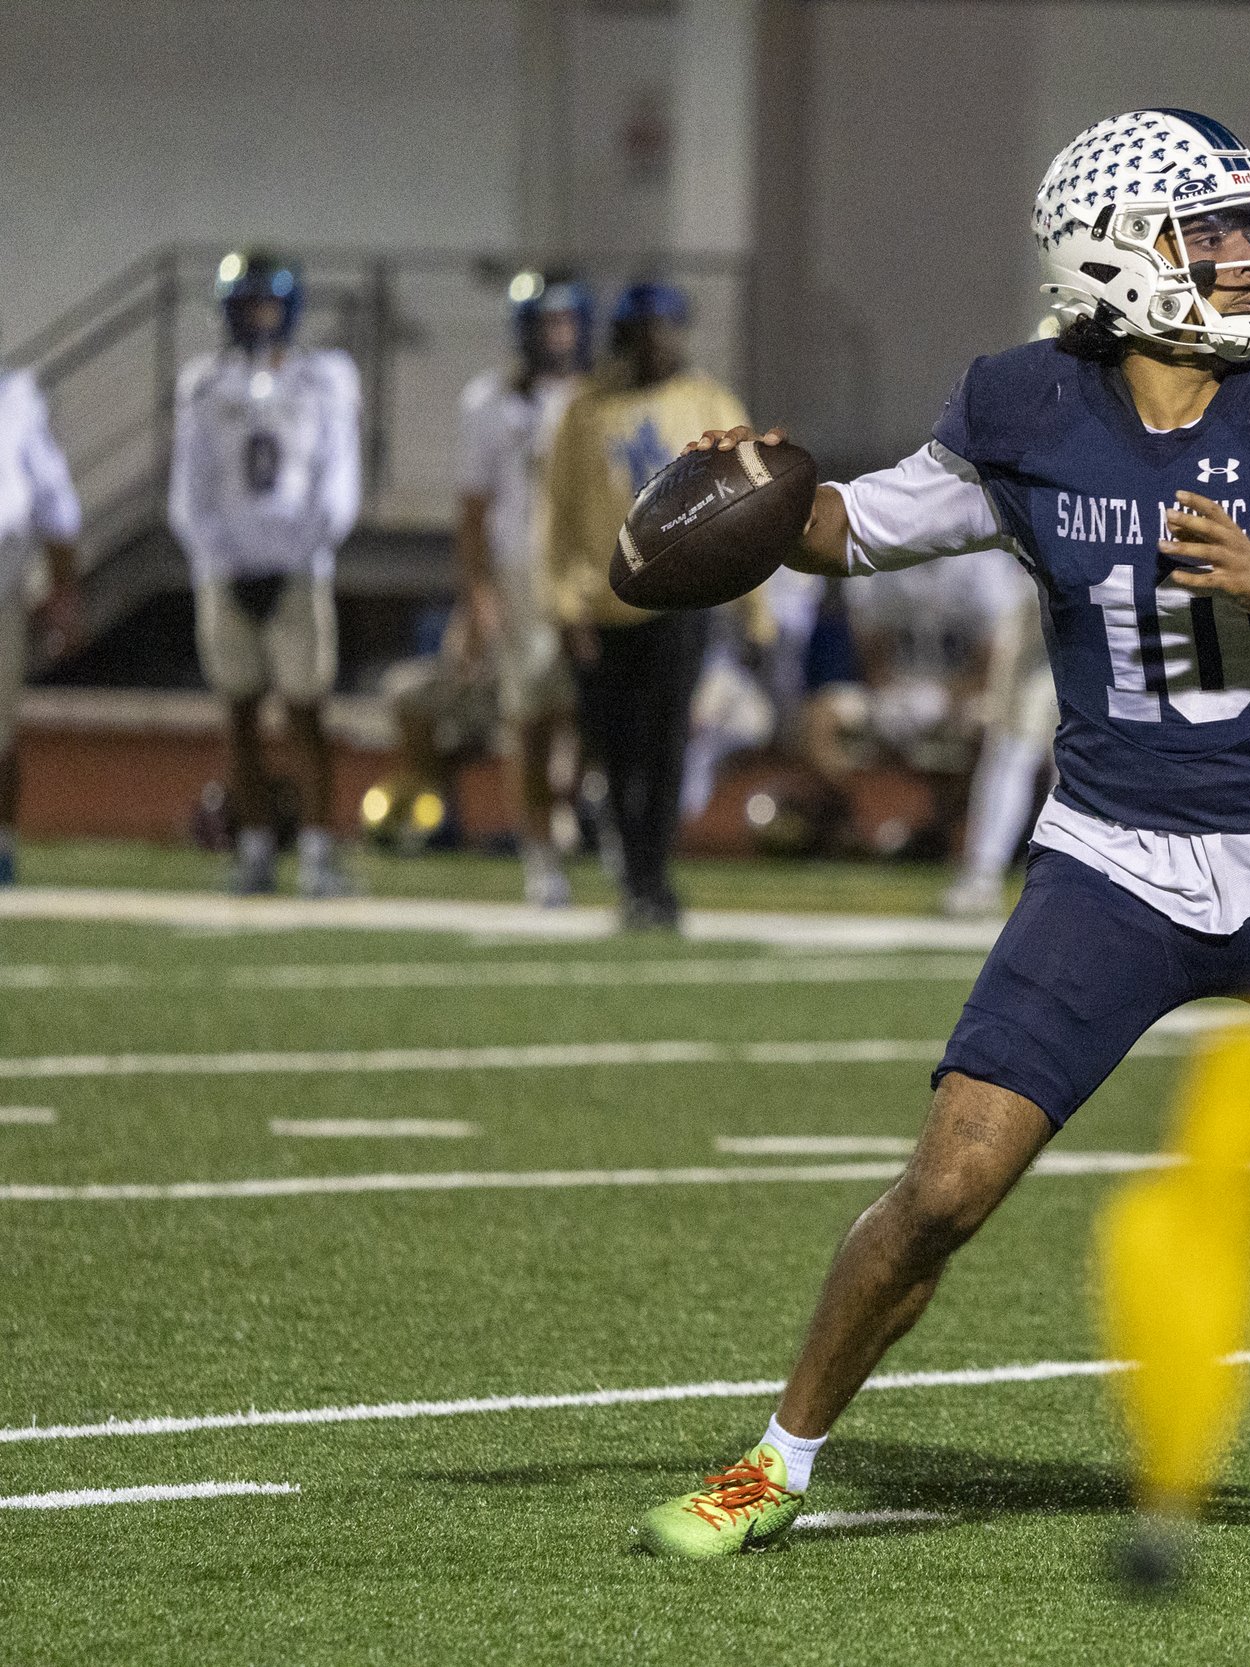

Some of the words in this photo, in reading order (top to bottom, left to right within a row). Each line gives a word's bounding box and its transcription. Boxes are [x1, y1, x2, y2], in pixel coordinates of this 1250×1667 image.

[714, 477, 735, 499] K
[660, 512, 687, 533] TEAM
[1056, 491, 1144, 545] SANTA
